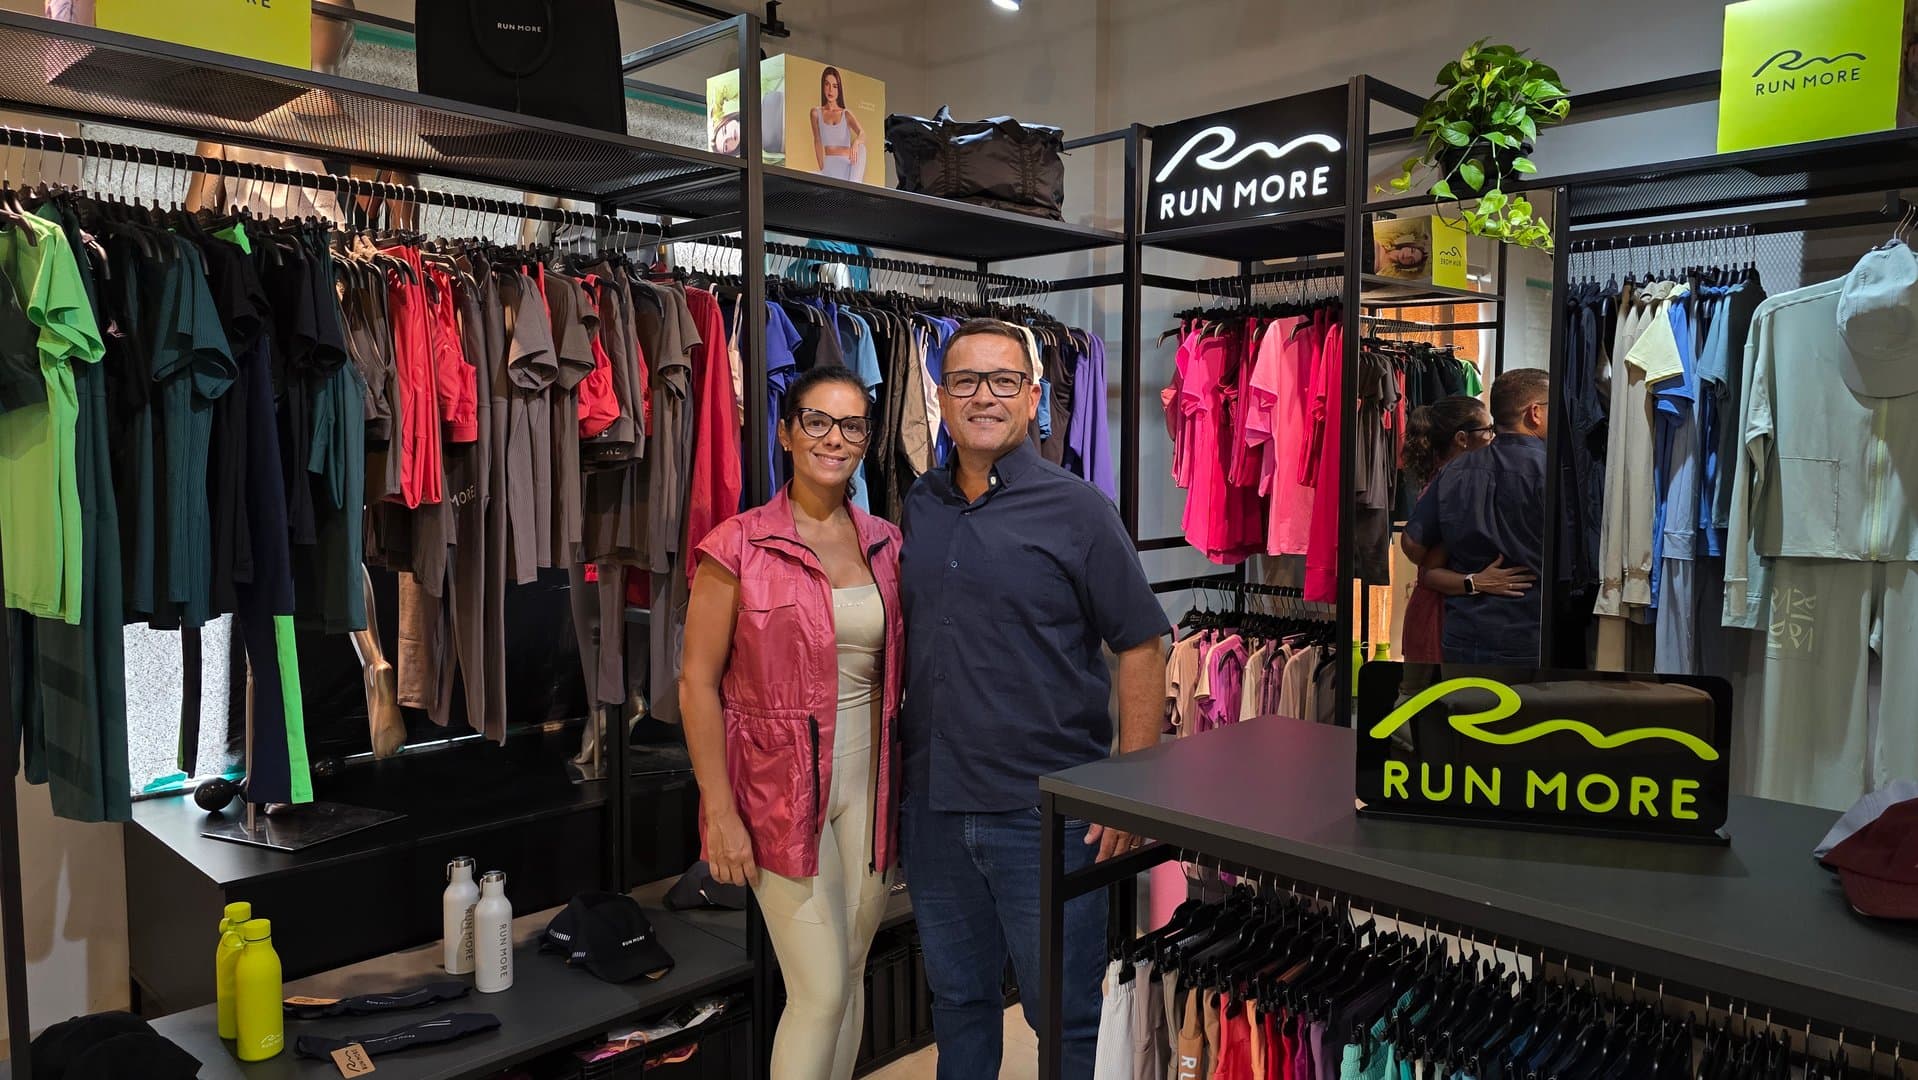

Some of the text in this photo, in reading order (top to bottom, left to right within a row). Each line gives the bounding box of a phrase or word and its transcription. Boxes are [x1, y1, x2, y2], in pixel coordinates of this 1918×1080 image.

[497, 22, 542, 33] RUN MORE
[1755, 67, 1861, 96] RUN MORE
[1159, 166, 1330, 220] RUN MORE
[1383, 760, 1700, 820] RUN MORE
[464, 908, 474, 961] RUN MORE
[499, 923, 508, 978] RUN MORE
